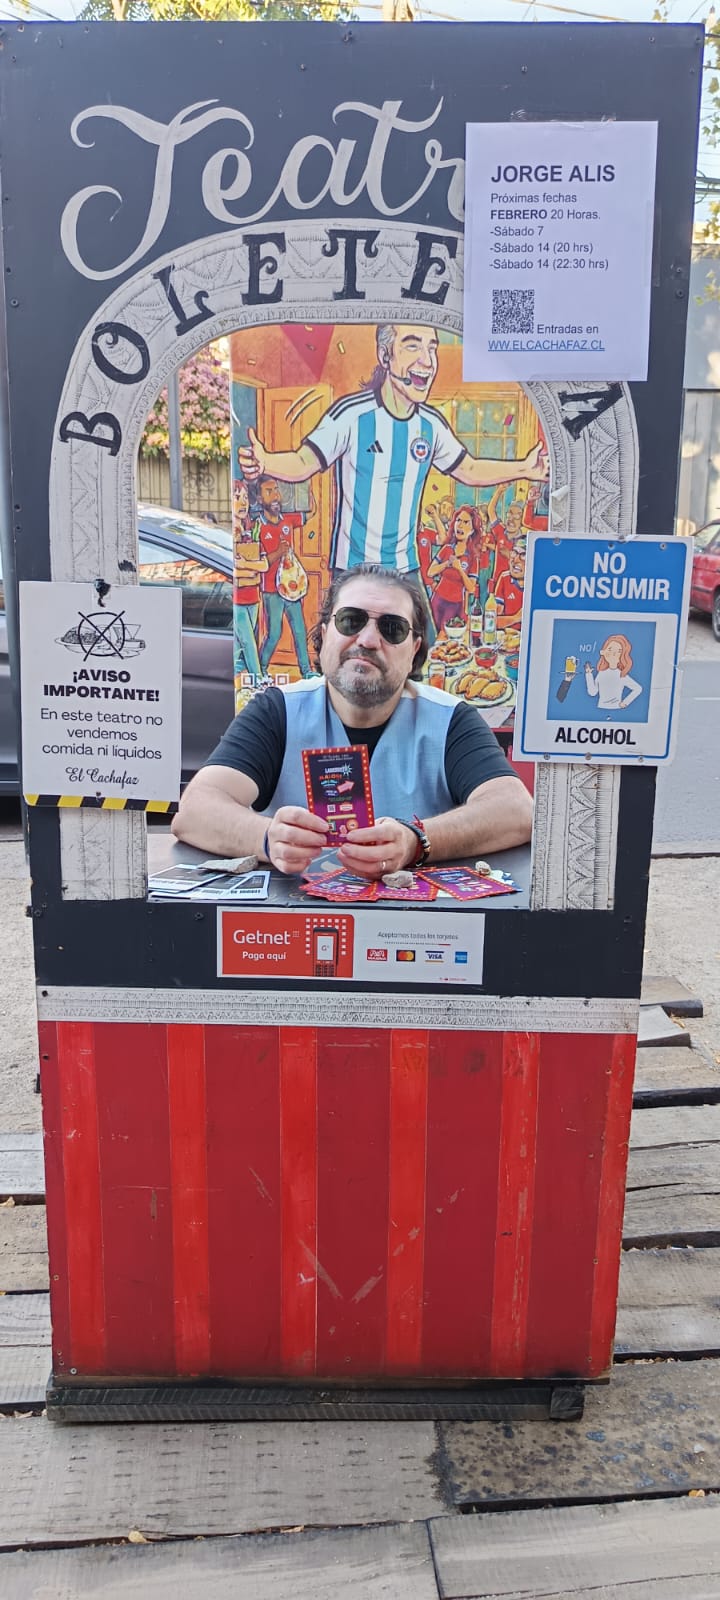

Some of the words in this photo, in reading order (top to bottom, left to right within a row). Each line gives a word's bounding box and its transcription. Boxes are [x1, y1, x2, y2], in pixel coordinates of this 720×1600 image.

[490, 165, 563, 183] JORGE
[568, 164, 616, 182] ALIS
[60, 97, 466, 280] Teatr
[490, 193, 539, 204] Próximas
[542, 192, 577, 203] fechas
[490, 209, 548, 220] FEBRERO
[550, 209, 564, 220] 20
[567, 209, 601, 220] Horas.
[489, 226, 535, 237] -Sábado
[538, 226, 545, 237] 7
[489, 242, 534, 253] -Sábado
[538, 242, 550, 253] 14
[553, 242, 571, 254] (20
[573, 242, 594, 254] hrs)
[489, 259, 534, 270] -Sábado
[538, 258, 550, 269] 14
[552, 258, 586, 271] (22:30
[588, 258, 609, 271] hrs)
[537, 324, 584, 334] Entradas
[586, 326, 599, 334] en
[592, 551, 627, 575] NO
[545, 575, 670, 601] CONSUMIR
[72, 669, 131, 683] ¡AVISO
[43, 684, 160, 702] IMPORTANTE!
[40, 708, 58, 720] En
[61, 709, 93, 722] este
[97, 711, 142, 724] teatro
[146, 716, 163, 726] no
[67, 727, 138, 741] vendemos
[555, 727, 636, 745] ALCOHOL
[42, 743, 93, 756] comida
[97, 745, 109, 757] ni
[112, 744, 162, 760] líquidos
[65, 766, 85, 782] El
[86, 768, 139, 789] Cachafaz
[233, 929, 291, 945] Getnet
[242, 951, 265, 961] Paga
[267, 951, 287, 962] aquí
